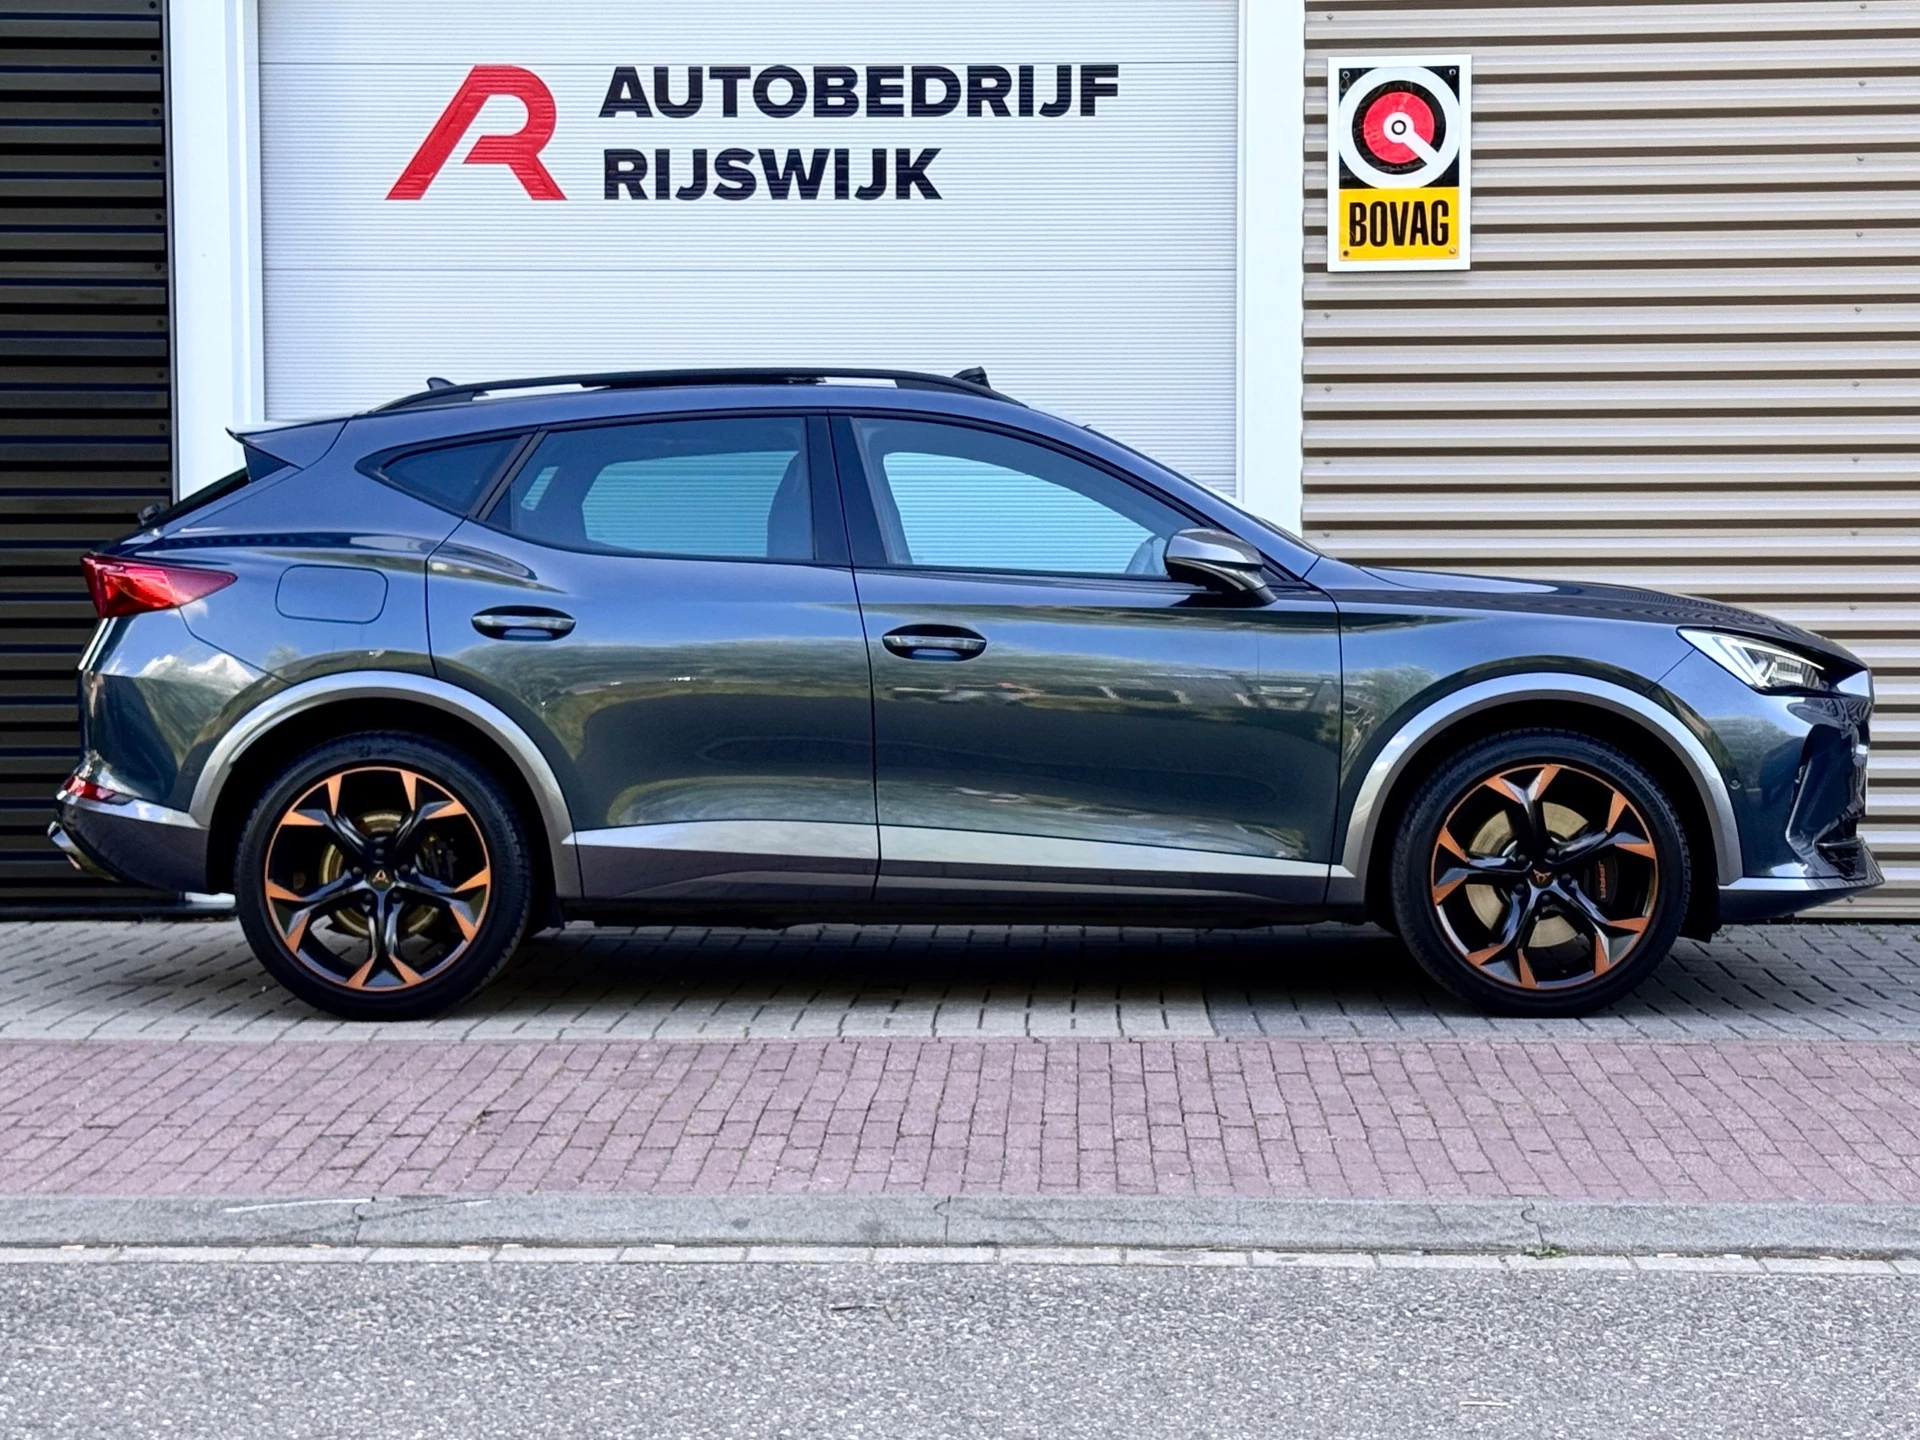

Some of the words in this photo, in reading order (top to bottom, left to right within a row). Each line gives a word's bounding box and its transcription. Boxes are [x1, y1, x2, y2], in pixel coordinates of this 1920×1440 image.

[599, 65, 1119, 118] AUTOBEDRIJF
[604, 148, 942, 200] RIJSWIJK
[1349, 200, 1449, 247] BOVAG
